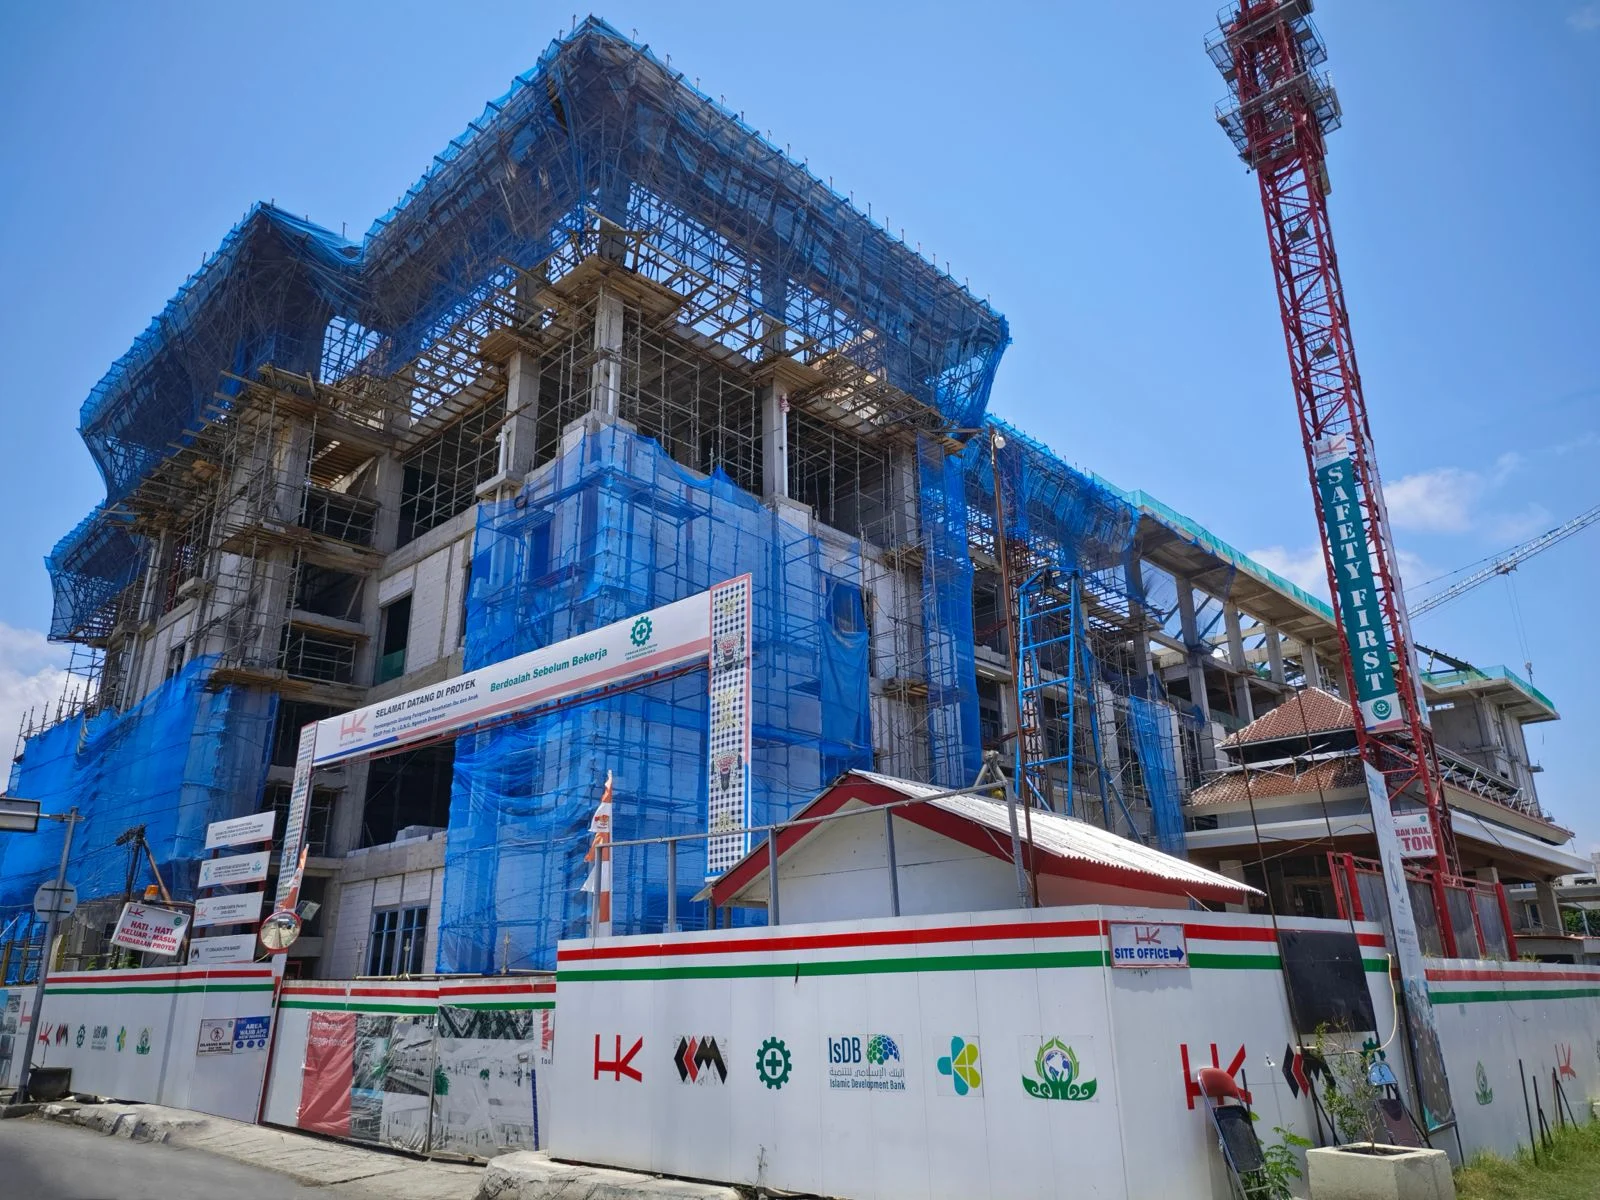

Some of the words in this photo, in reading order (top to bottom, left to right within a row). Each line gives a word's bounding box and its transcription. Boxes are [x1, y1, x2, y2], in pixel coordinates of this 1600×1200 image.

[1327, 466, 1362, 580] SAFETY
[1350, 588, 1384, 692] FIRST
[490, 671, 531, 692] Berdoalah
[532, 660, 570, 679] Sebelum
[572, 648, 608, 667] Bekerja
[375, 702, 407, 718] SELAMAT
[407, 692, 435, 708] DATANG
[436, 689, 444, 699] DI
[445, 679, 476, 696] PROYEK
[1395, 828, 1411, 837] BAN
[1402, 835, 1434, 852] TON
[121, 927, 148, 939] KELUAR
[152, 934, 177, 944] MASUK
[130, 920, 149, 931] HATI
[154, 925, 173, 936] HATI
[118, 935, 152, 948] KENDARAAN
[152, 942, 176, 952] PROYEK
[1114, 948, 1135, 960] SITE
[1137, 948, 1169, 960] OFFICE
[829, 1037, 862, 1064] IsDB
[829, 1079, 850, 1088] Islamic
[851, 1079, 889, 1090] Development
[890, 1080, 906, 1090] Bank
